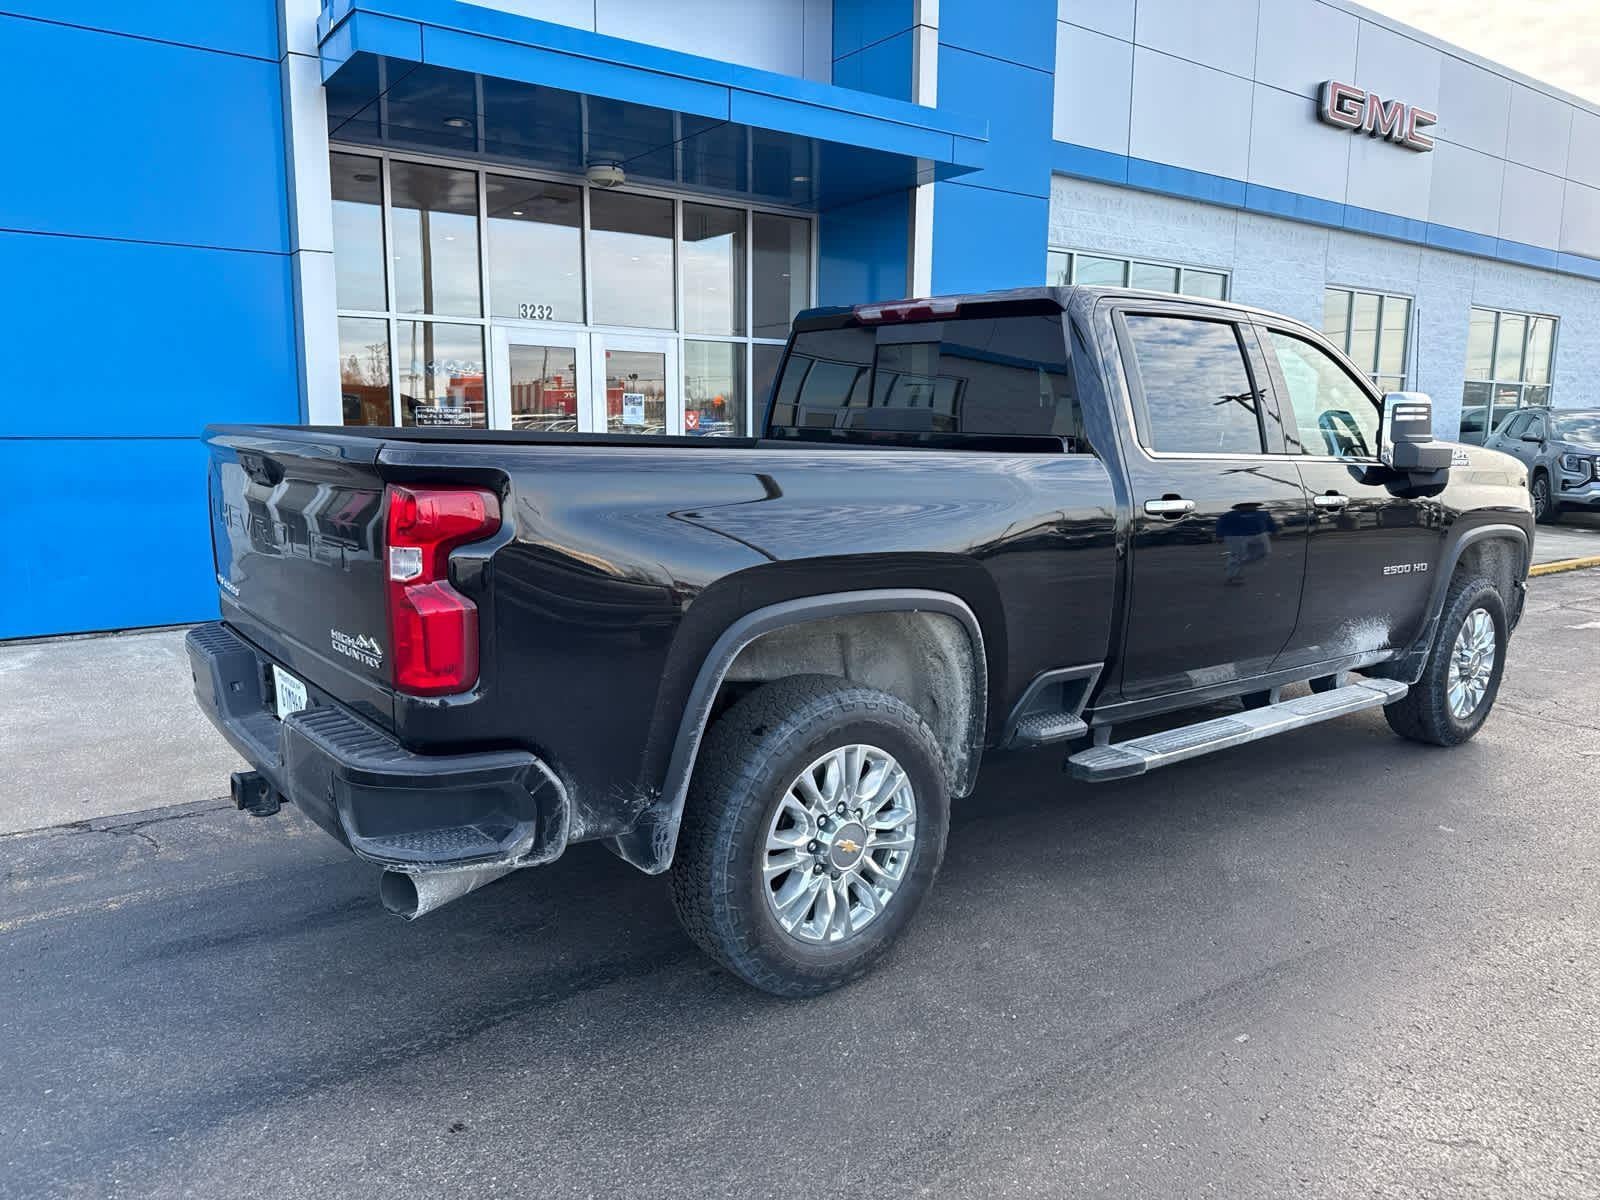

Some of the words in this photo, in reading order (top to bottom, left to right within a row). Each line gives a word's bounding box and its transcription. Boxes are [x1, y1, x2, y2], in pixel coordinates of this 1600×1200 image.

[1319, 80, 1438, 151] GMC
[520, 303, 553, 320] 3232
[1383, 564, 1411, 575] 2500
[1413, 562, 1428, 571] HD
[330, 628, 355, 648] HIGH
[331, 639, 382, 669] COUNTRY
